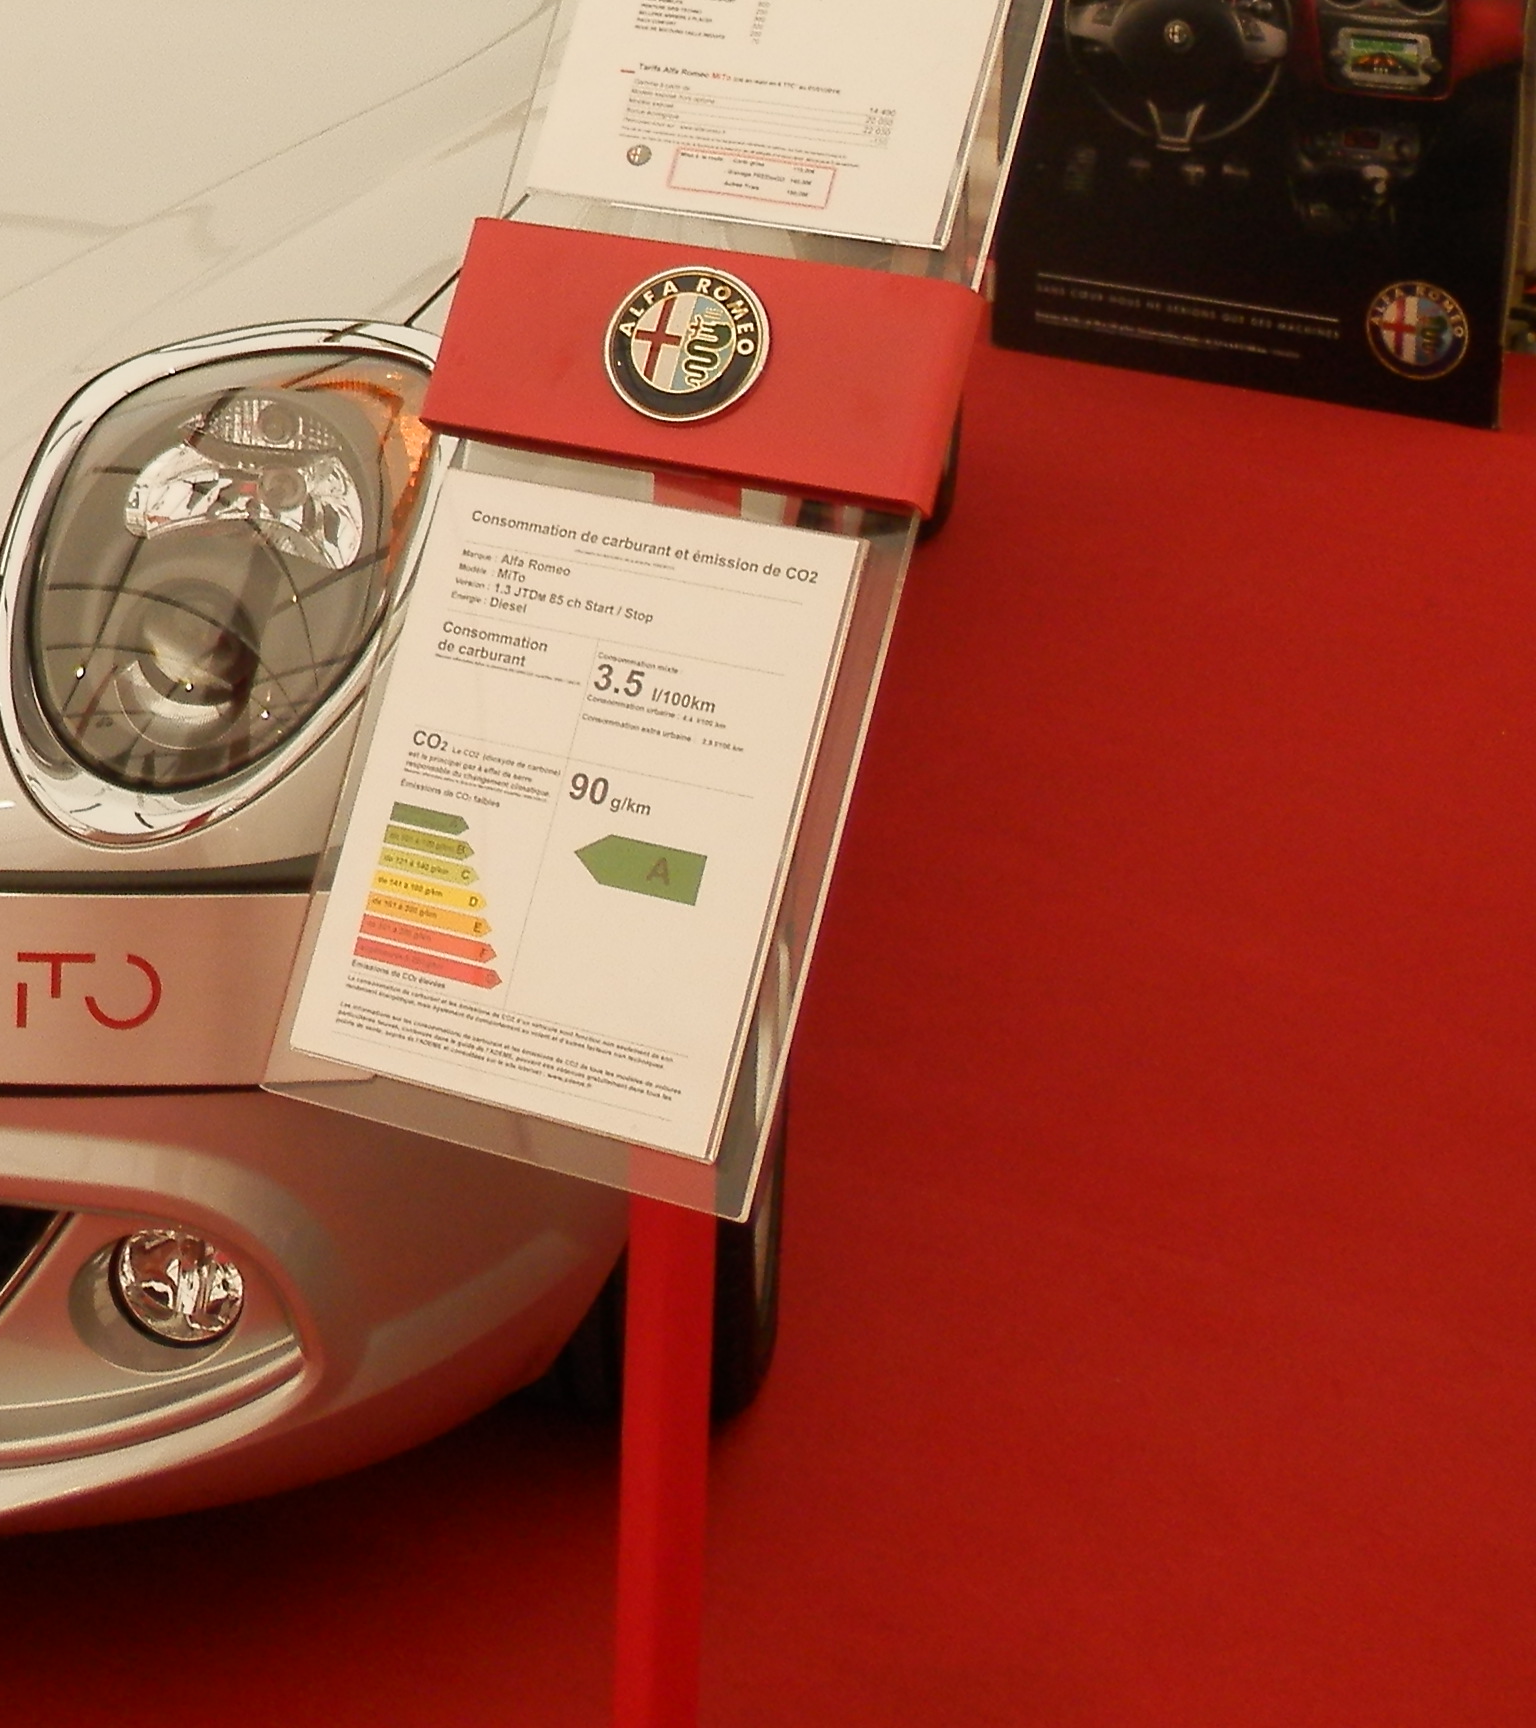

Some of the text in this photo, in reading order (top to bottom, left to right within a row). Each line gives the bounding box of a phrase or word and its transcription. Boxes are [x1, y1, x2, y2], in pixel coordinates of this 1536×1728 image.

[619, 277, 754, 356] ALFA ROMEO
[471, 509, 578, 541] Consommation
[580, 528, 599, 544] de
[601, 533, 672, 557] carburant
[674, 548, 690, 561] et
[692, 550, 759, 573] émission
[762, 562, 782, 577] de
[785, 566, 819, 584] CO2
[497, 567, 527, 583] MiTo
[500, 553, 525, 569] Alfa
[528, 559, 572, 577] Romeo
[489, 596, 528, 614] Diesel
[494, 582, 512, 596] 1.3
[548, 593, 565, 606] 85
[566, 597, 582, 609] ch
[584, 599, 618, 617] Start
[624, 607, 654, 623] Stop
[442, 620, 549, 654] Consommation
[437, 638, 527, 668] de carburant
[597, 651, 656, 670] Consommation
[593, 663, 646, 698] 3.5
[412, 729, 449, 753] CO2
[569, 772, 609, 805] 90
[610, 797, 651, 816] g/km
[646, 857, 670, 887] A
[468, 896, 479, 908] D
[473, 921, 483, 934] E
